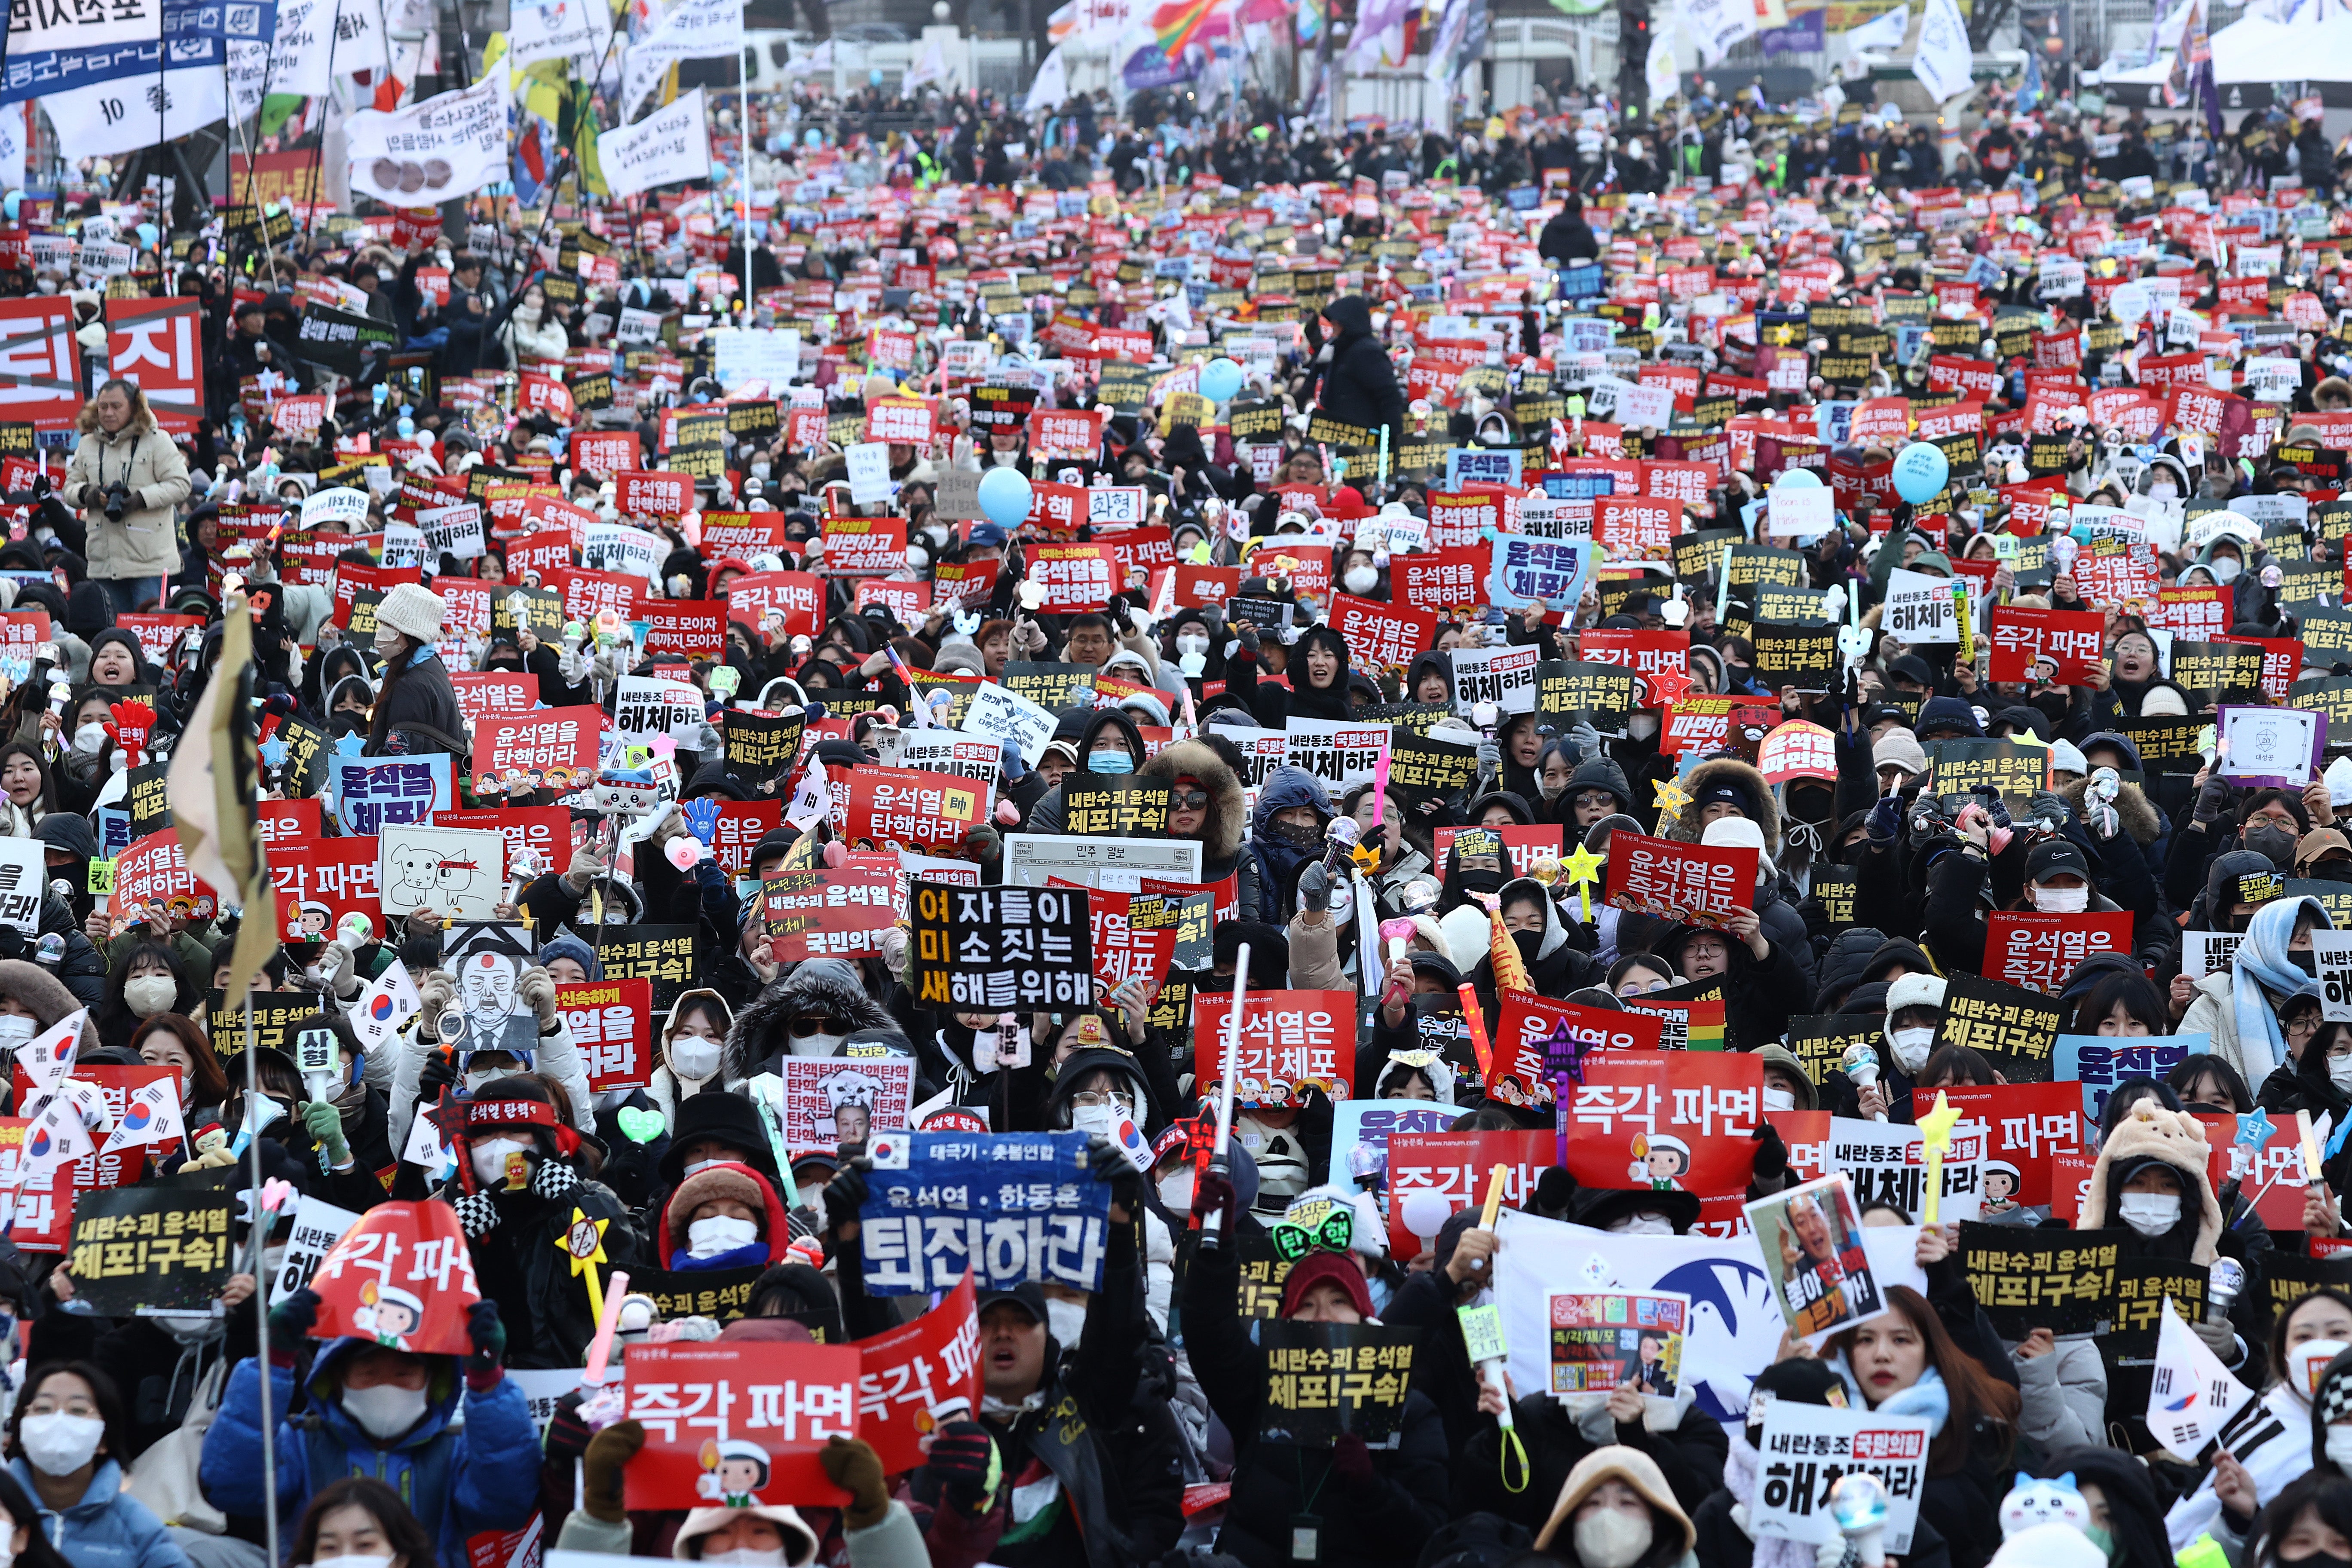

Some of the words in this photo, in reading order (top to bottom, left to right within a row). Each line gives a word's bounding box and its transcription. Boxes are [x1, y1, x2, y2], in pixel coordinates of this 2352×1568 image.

[113, 316, 196, 405] 진
[1962, 371, 1993, 391] 파면
[2174, 363, 2205, 383] 파면
[528, 383, 567, 410] 탄핵
[871, 404, 931, 425] 윤석열을
[1041, 417, 1091, 434] 윤석열을
[1040, 432, 1090, 448] 탄핵하라
[1649, 469, 1707, 486] 윤석열은
[627, 479, 683, 498] 윤석열을
[627, 496, 682, 514] 탄핵하라
[1092, 491, 1130, 519] 화형
[1773, 493, 1798, 508] Yoon
[1802, 498, 1811, 507] is
[1523, 509, 1553, 520] 내란동조
[1556, 506, 1593, 519] 국민의힘
[1603, 507, 1669, 528] 윤석열은
[2075, 516, 2108, 525] 내란동조
[825, 533, 894, 551] 파면하고
[533, 544, 570, 570] 파면
[831, 551, 903, 569] 구속하라!
[1066, 547, 1100, 559] 신속하게
[1136, 541, 1175, 564] 파면
[1506, 541, 1578, 571] 윤석열
[1033, 560, 1110, 580] 윤석열을
[1407, 562, 1475, 588] 윤석열을
[568, 578, 634, 605] 윤석열은
[1294, 576, 1329, 590] 모이자
[1513, 570, 1568, 599] 체포!
[732, 591, 771, 612] 즉각
[775, 587, 814, 612] 파면
[858, 588, 919, 607] 윤석열은
[1407, 583, 1476, 606] 탄핵하라
[1892, 593, 1931, 603] 내란동조
[678, 618, 717, 632] 모이자
[1343, 609, 1421, 645] 윤석열은
[685, 634, 723, 649] 모이자
[1756, 638, 1796, 652] 내란수괴
[1798, 637, 1834, 652] 윤석열
[1994, 624, 2044, 653] 즉각
[2049, 630, 2102, 660] 파면
[1756, 651, 1833, 671] 체포!구속!
[2175, 654, 2223, 670] 내란수괴
[2225, 654, 2260, 669] 윤석열
[1007, 676, 1056, 689] 내란수괴
[1059, 673, 1092, 687] 윤석열
[1458, 671, 1536, 705] 해체하라
[1542, 676, 1592, 692] 내란수괴
[1595, 676, 1630, 690] 윤석열
[2175, 669, 2260, 690] 체포!구속!
[452, 683, 526, 707] 윤석열은
[621, 691, 662, 703] 내란동조
[664, 689, 702, 707] 국민의힘
[980, 692, 1002, 706] 안개
[1541, 690, 1629, 714] 체포!구속!
[119, 726, 144, 747] 탄핵
[495, 721, 580, 749] 윤석열을
[771, 723, 802, 744] 윤석열
[876, 737, 896, 750] 탄핵
[1290, 733, 1333, 749] 내란동조
[1334, 730, 1387, 749] 국민의힘
[2260, 737, 2270, 745] 20
[492, 743, 579, 769] 탄핵하라
[904, 747, 952, 761] 내란동조
[954, 743, 999, 763] 국민의힘
[1391, 748, 1440, 766] 내란수괴
[2255, 753, 2274, 762] 대성공
[857, 766, 879, 776] 나눔문화
[1938, 758, 1991, 776] 내란수괴
[1993, 756, 2043, 775] 윤석열
[872, 784, 942, 817] 윤석열
[1129, 788, 1169, 806] 윤석열
[459, 813, 499, 821] www.nanum.com
[1067, 808, 1166, 834] 체포!구속!
[870, 813, 963, 844] 탄핵하라
[1454, 827, 1482, 837] 2차계엄분쇄!
[266, 844, 309, 852] www.nanum.com
[1454, 832, 1485, 847] 국지전
[1616, 832, 1640, 843] 나눔문화
[1640, 839, 1683, 852] www.nanum.com
[1077, 845, 1097, 859] 민주
[1459, 842, 1499, 858] 도발중단!
[1628, 850, 1736, 892] 윤석열은
[2239, 870, 2269, 882] 2차계엄분쇄!
[119, 869, 198, 908] 탄핵하라
[319, 863, 379, 900] 파면
[1144, 882, 1167, 891] 나눔문화
[2239, 876, 2271, 894] 국지전
[769, 894, 823, 911] 내란수괴
[826, 886, 891, 907] 윤석열
[1129, 894, 1162, 903] 2차계엄분쇄!
[2244, 883, 2284, 901] 도발중단!
[1128, 900, 1164, 917] 국지전
[1682, 887, 1734, 919] 체포
[769, 916, 806, 937] 해체!
[1131, 909, 1179, 929] 도발중단!
[645, 937, 692, 958] 윤석열
[2006, 929, 2113, 954] 윤석열은
[559, 988, 620, 1006] 신속하게
[1199, 996, 1225, 1005] 나눔문화
[1508, 992, 1534, 1006] 나눔문화
[1534, 1001, 1581, 1018] www.nanum.com
[1949, 996, 2018, 1029] 내란수괴
[2020, 1008, 2061, 1032] 윤석열
[1942, 1016, 2053, 1062] 체포!구속!
[1608, 1058, 1664, 1066] www.nanum.com
[503, 1100, 530, 1119] 탄핵
[1572, 1084, 1662, 1137] 즉각
[1670, 1084, 1758, 1137] 파면
[1425, 1139, 1480, 1148] www.nanum.com
[2000, 1110, 2079, 1158] 파면
[929, 1143, 978, 1162] 태극기
[992, 1143, 1055, 1162] 촛불연합
[1834, 1142, 1903, 1164] 내란동조
[997, 1182, 1082, 1212] 한동훈
[76, 1213, 159, 1241] 내란수괴
[162, 1207, 227, 1236] 윤석열
[70, 1235, 227, 1280] 체포!구속!
[862, 1214, 1106, 1292] 퇴진하라
[1967, 1250, 2052, 1274] 내란수괴
[2057, 1243, 2118, 1270] 윤석열
[1784, 1273, 1824, 1313] 좋아
[1966, 1269, 2115, 1308] 체포!구속!
[2143, 1275, 2203, 1300] 윤석열
[1553, 1295, 1628, 1325] 윤석열
[1636, 1297, 1682, 1329] 탄핵
[670, 1351, 739, 1359] www.nanum.com
[1472, 1338, 1502, 1357] OUT
[1269, 1348, 1352, 1372] 내란수괴
[1357, 1344, 1414, 1371] 윤석열
[1267, 1373, 1409, 1410] 체포!구속!
[628, 1379, 735, 1443] 즉각
[746, 1379, 853, 1442] 파면
[1770, 1432, 1850, 1455] 내란동조
[1853, 1430, 1924, 1459] 국민의힘
